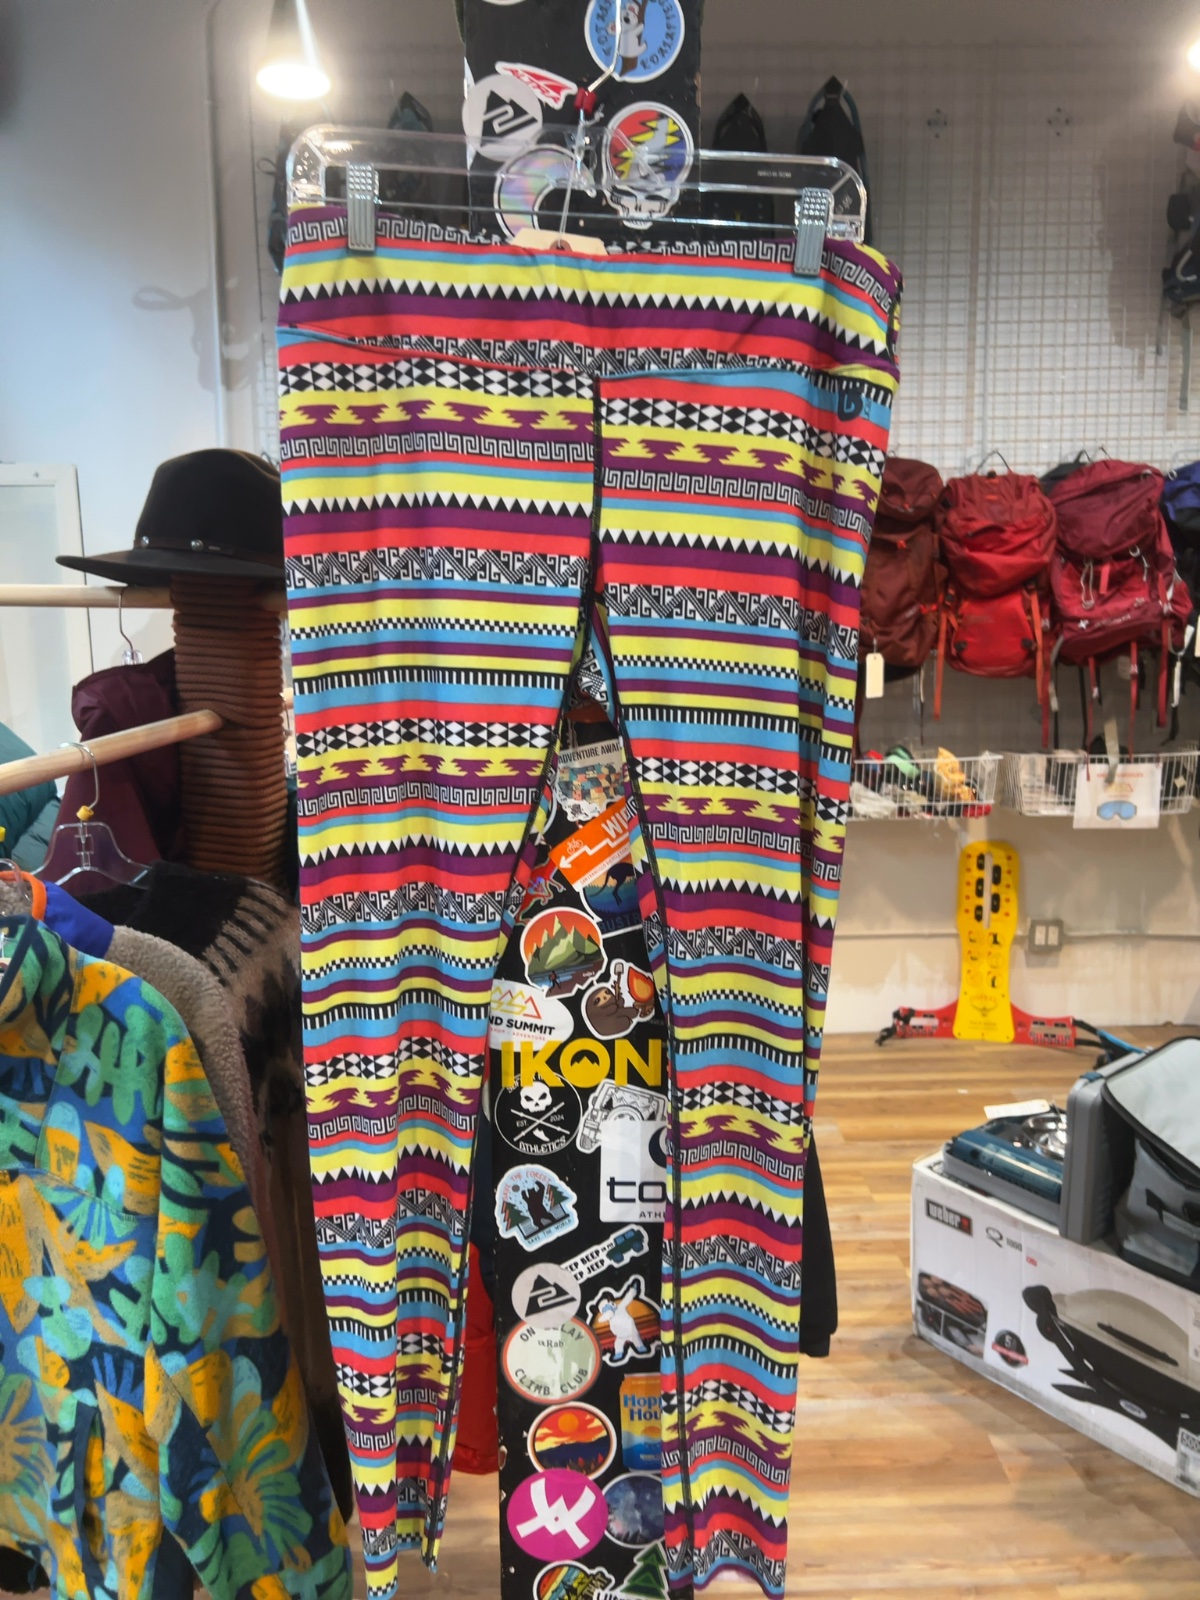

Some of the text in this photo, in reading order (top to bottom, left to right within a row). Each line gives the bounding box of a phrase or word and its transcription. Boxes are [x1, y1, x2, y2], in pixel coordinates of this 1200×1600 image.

[558, 746, 600, 764] ADVENTURE
[506, 1018, 556, 1036] SUMMIT
[512, 1031, 546, 1041] ADVENTURE
[501, 1038, 662, 1088] IKON
[550, 1114, 565, 1122] 2024
[519, 1135, 567, 1153] ATHLETICS
[554, 1218, 572, 1230] WORLD
[580, 1249, 600, 1265] BEEP
[587, 1258, 605, 1274] JEEP
[520, 1327, 536, 1342] ON
[515, 1368, 588, 1396] CLIMB CLUB
